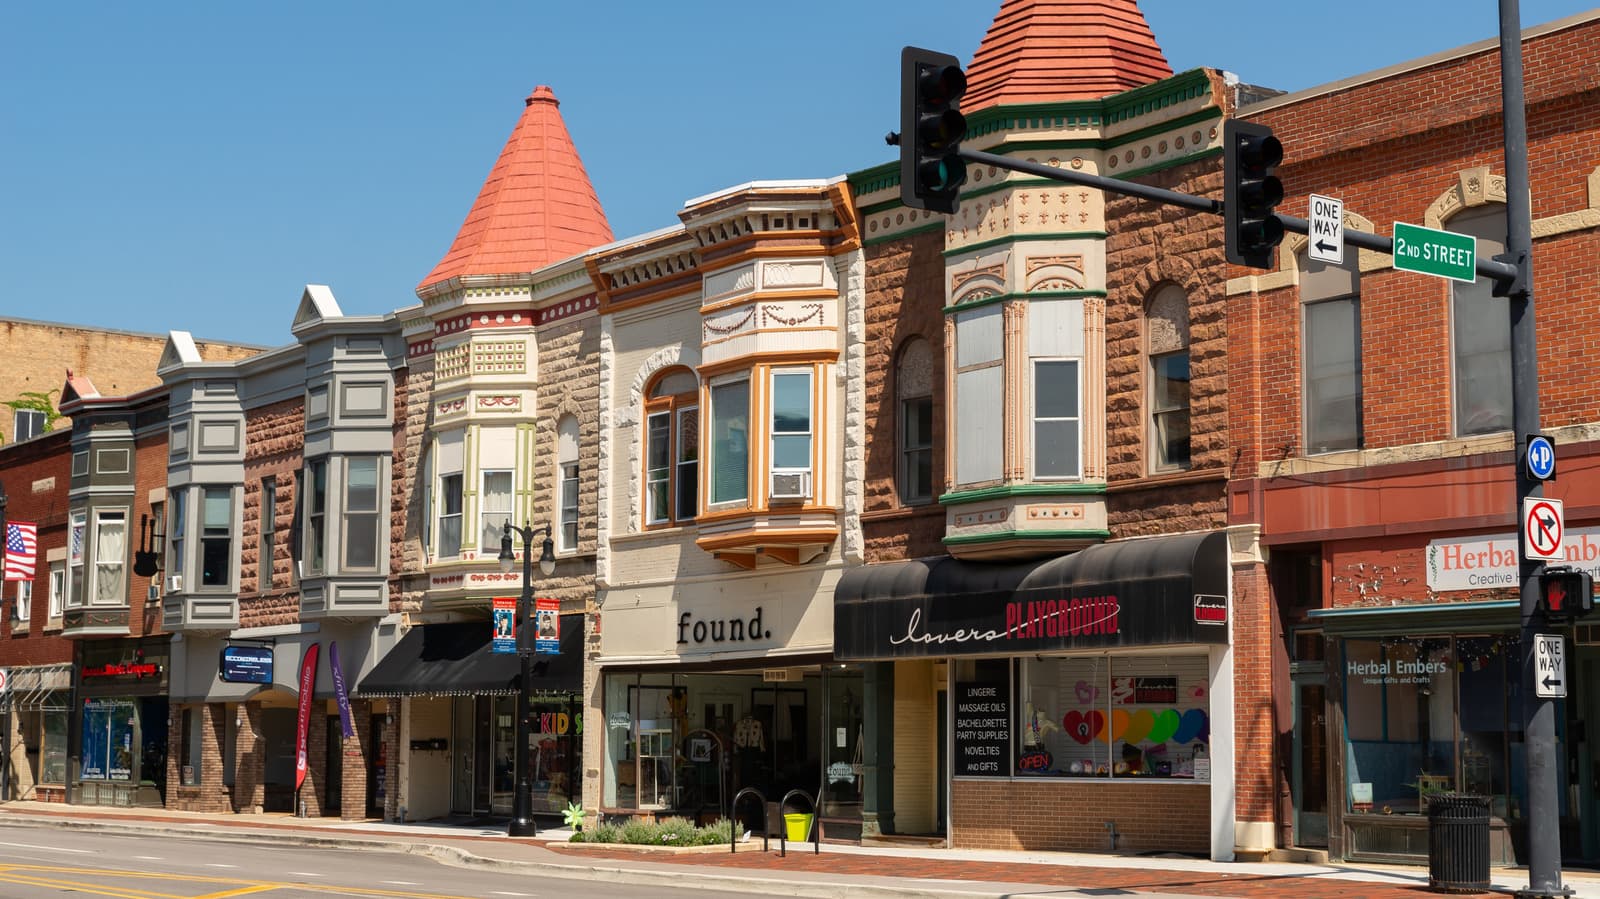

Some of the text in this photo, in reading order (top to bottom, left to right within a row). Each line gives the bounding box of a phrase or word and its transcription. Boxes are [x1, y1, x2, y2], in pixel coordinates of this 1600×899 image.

[1315, 201, 1338, 219] ONE
[1314, 219, 1339, 237] WAY
[1397, 238, 1472, 268] 2ND STREET
[1441, 533, 1600, 570] Herba mb
[1468, 570, 1513, 585] Creative
[677, 606, 771, 644] found.
[890, 596, 1118, 644] lovers PLAYGROUND
[1539, 641, 1561, 655] ONE
[1347, 658, 1446, 675] Herbal Embers
[1539, 658, 1561, 672] WAY
[1384, 676, 1398, 684] Gifts
[1400, 676, 1411, 684] and
[1412, 675, 1431, 684] Crafts
[967, 688, 997, 697] LINGERIE
[958, 703, 1006, 713] MASSAGE OILS
[541, 713, 569, 735] KID
[957, 718, 1007, 728] BACHELORETTE
[956, 730, 1008, 740] PARTY SUPPLIES
[964, 746, 1000, 756] NOVELTIES
[979, 762, 998, 771] GIFTS
[1019, 754, 1049, 769] OPEN
